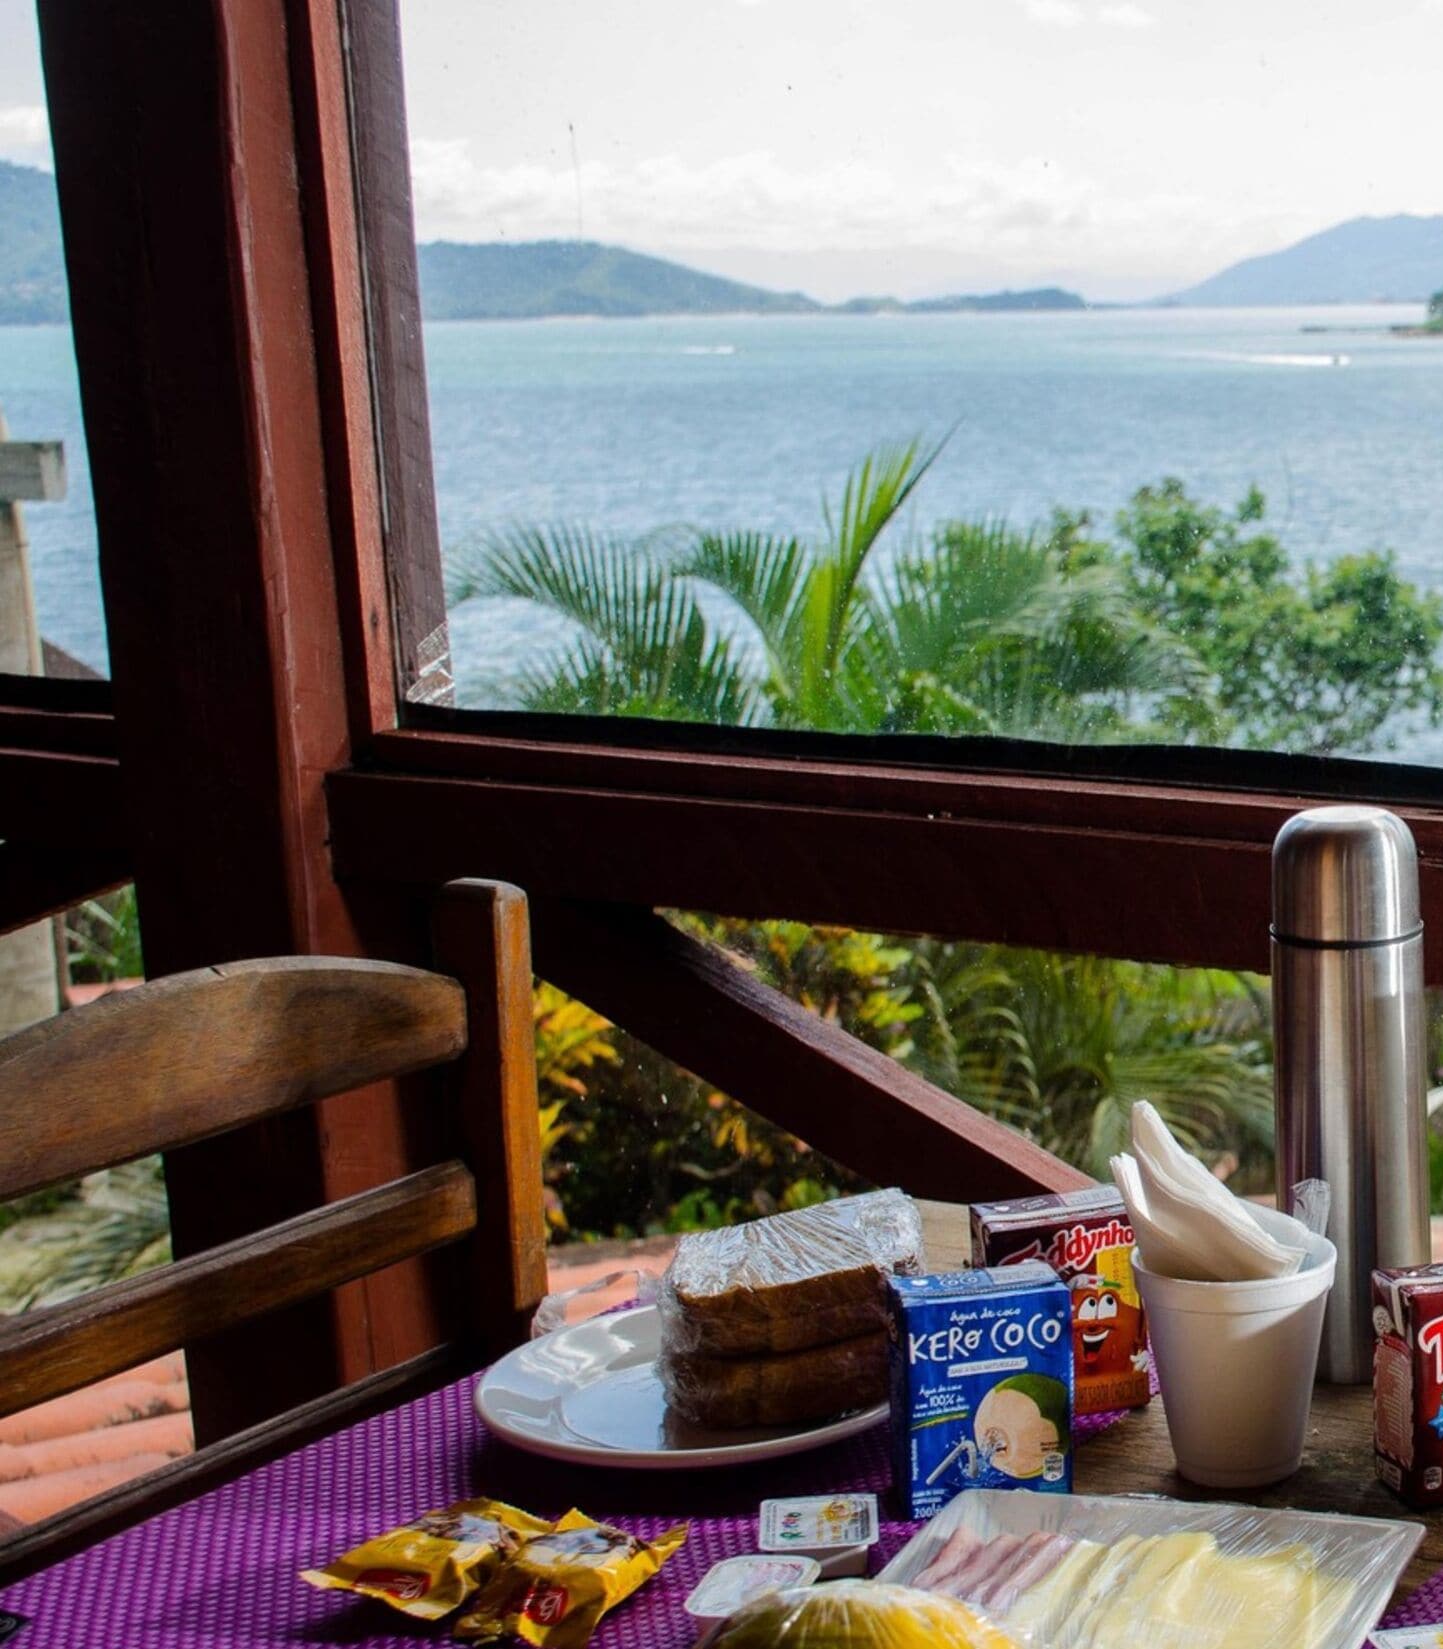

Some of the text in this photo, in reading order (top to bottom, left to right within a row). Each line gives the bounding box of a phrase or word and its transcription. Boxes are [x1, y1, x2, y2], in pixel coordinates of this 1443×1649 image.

[994, 1307, 1021, 1318] coco
[908, 1312, 1062, 1365] KERO COCO
[929, 1393, 956, 1408] 100%
